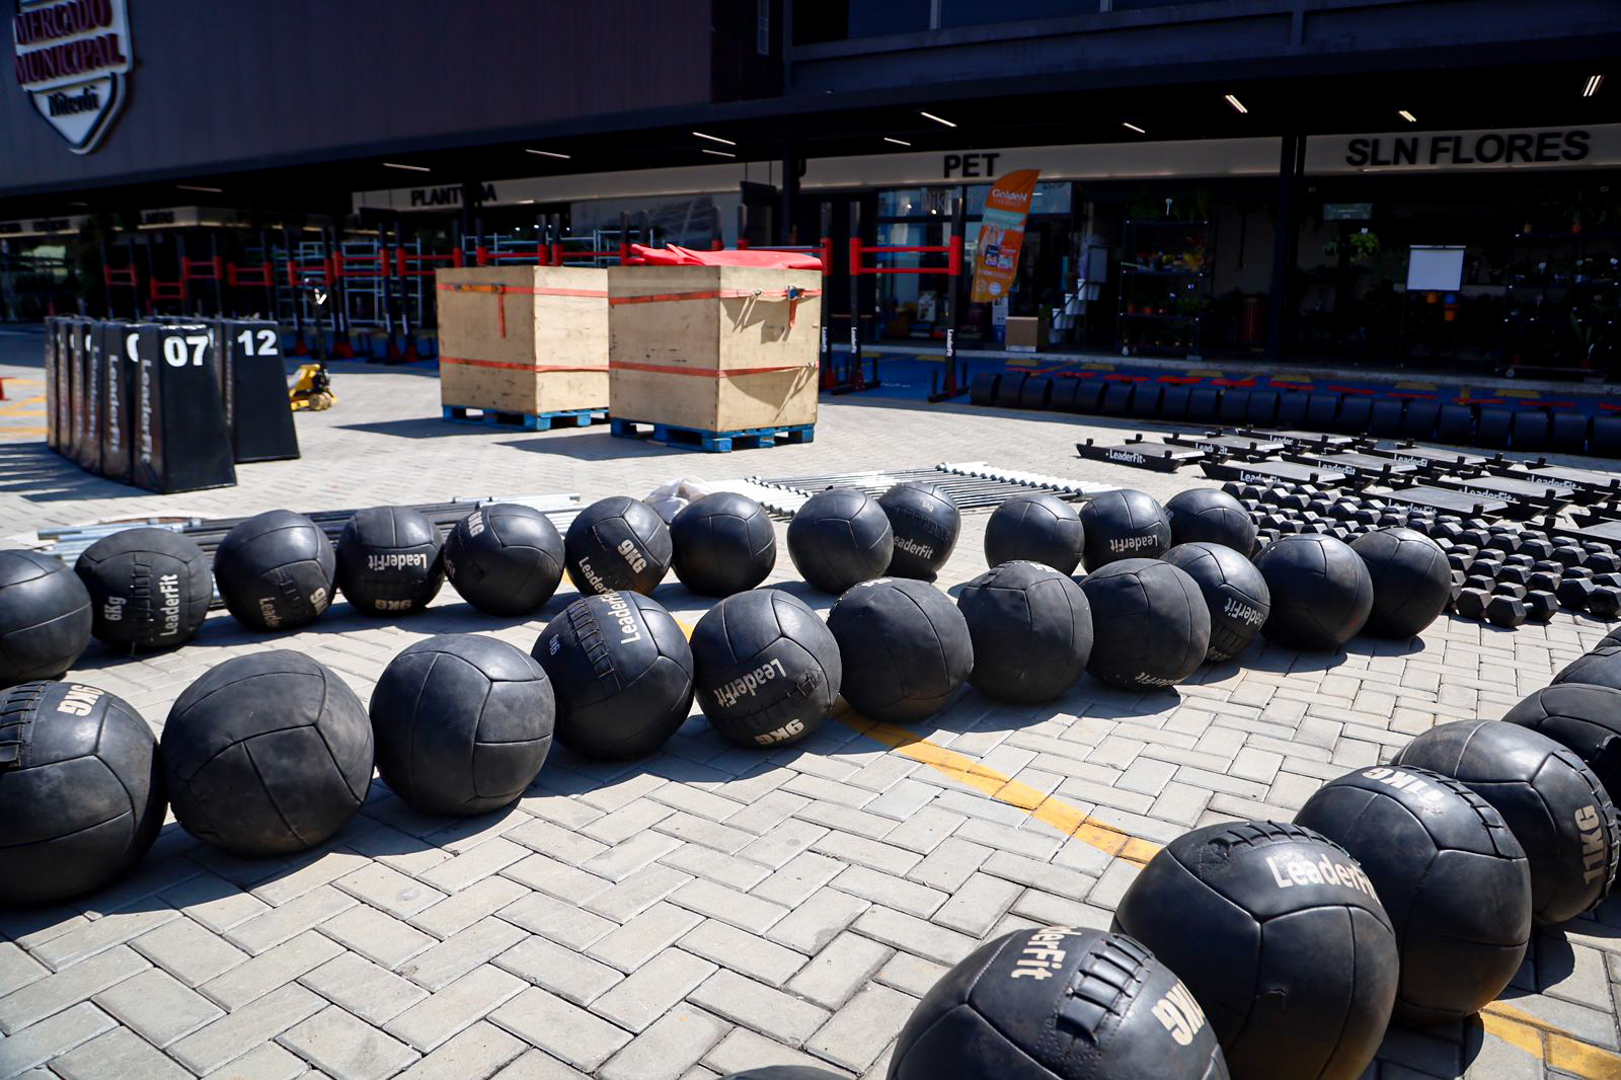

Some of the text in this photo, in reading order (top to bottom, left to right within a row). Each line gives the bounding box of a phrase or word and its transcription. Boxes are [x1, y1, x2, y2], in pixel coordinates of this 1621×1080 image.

[16, 0, 111, 44] MERCADO
[16, 34, 126, 85] MUNICIPAL
[1346, 131, 1590, 166] SLN FLORES
[944, 153, 999, 178] PET
[163, 336, 209, 367] 07
[237, 329, 279, 356] 12
[1109, 449, 1143, 464] LeaderFit
[617, 539, 648, 574] 9KG
[893, 535, 934, 560] eaderFit
[1110, 535, 1158, 553] LeaderFit
[368, 553, 427, 571] LeaderFit
[104, 596, 127, 621] 6Kg
[159, 573, 180, 636] LeaderFit
[713, 658, 787, 708] LeaderFit
[754, 718, 805, 745] 9KG
[1574, 804, 1604, 886] 11KG
